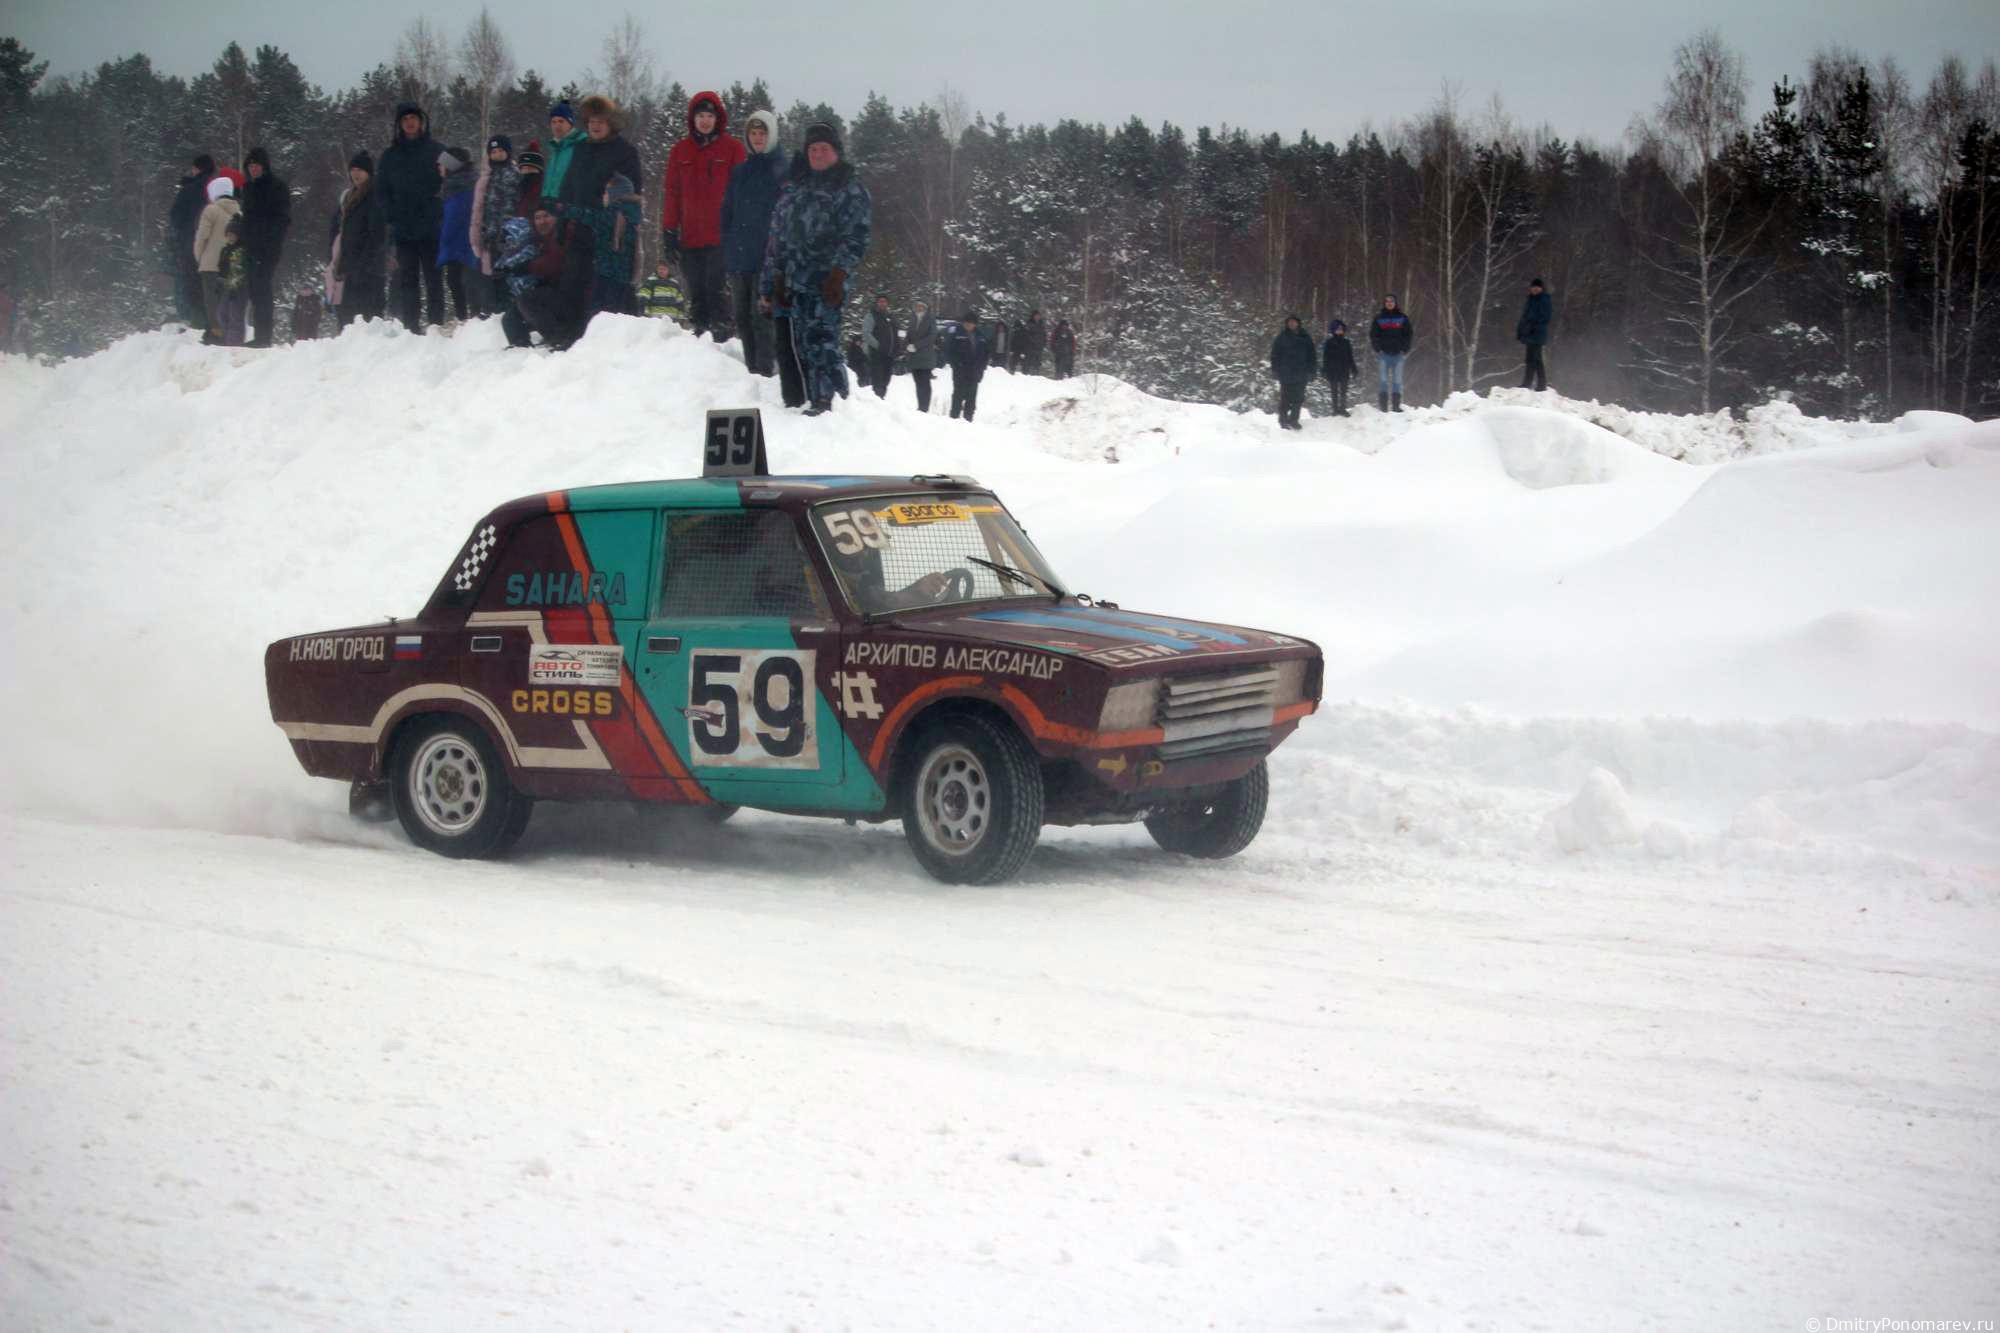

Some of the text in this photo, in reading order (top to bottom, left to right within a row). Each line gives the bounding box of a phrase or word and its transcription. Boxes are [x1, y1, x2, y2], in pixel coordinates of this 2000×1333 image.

[706, 416, 755, 466] 59
[822, 508, 890, 555] 59
[505, 571, 627, 606] SAHARA
[289, 636, 385, 662] Н.НОВГОРОД
[534, 661, 582, 670] АВТО
[844, 642, 1064, 680] АРХИПОВ АЛЕКСАНДР
[533, 670, 583, 679] СТИЛЬ
[511, 690, 612, 715] CROSS
[691, 655, 806, 757] 59
